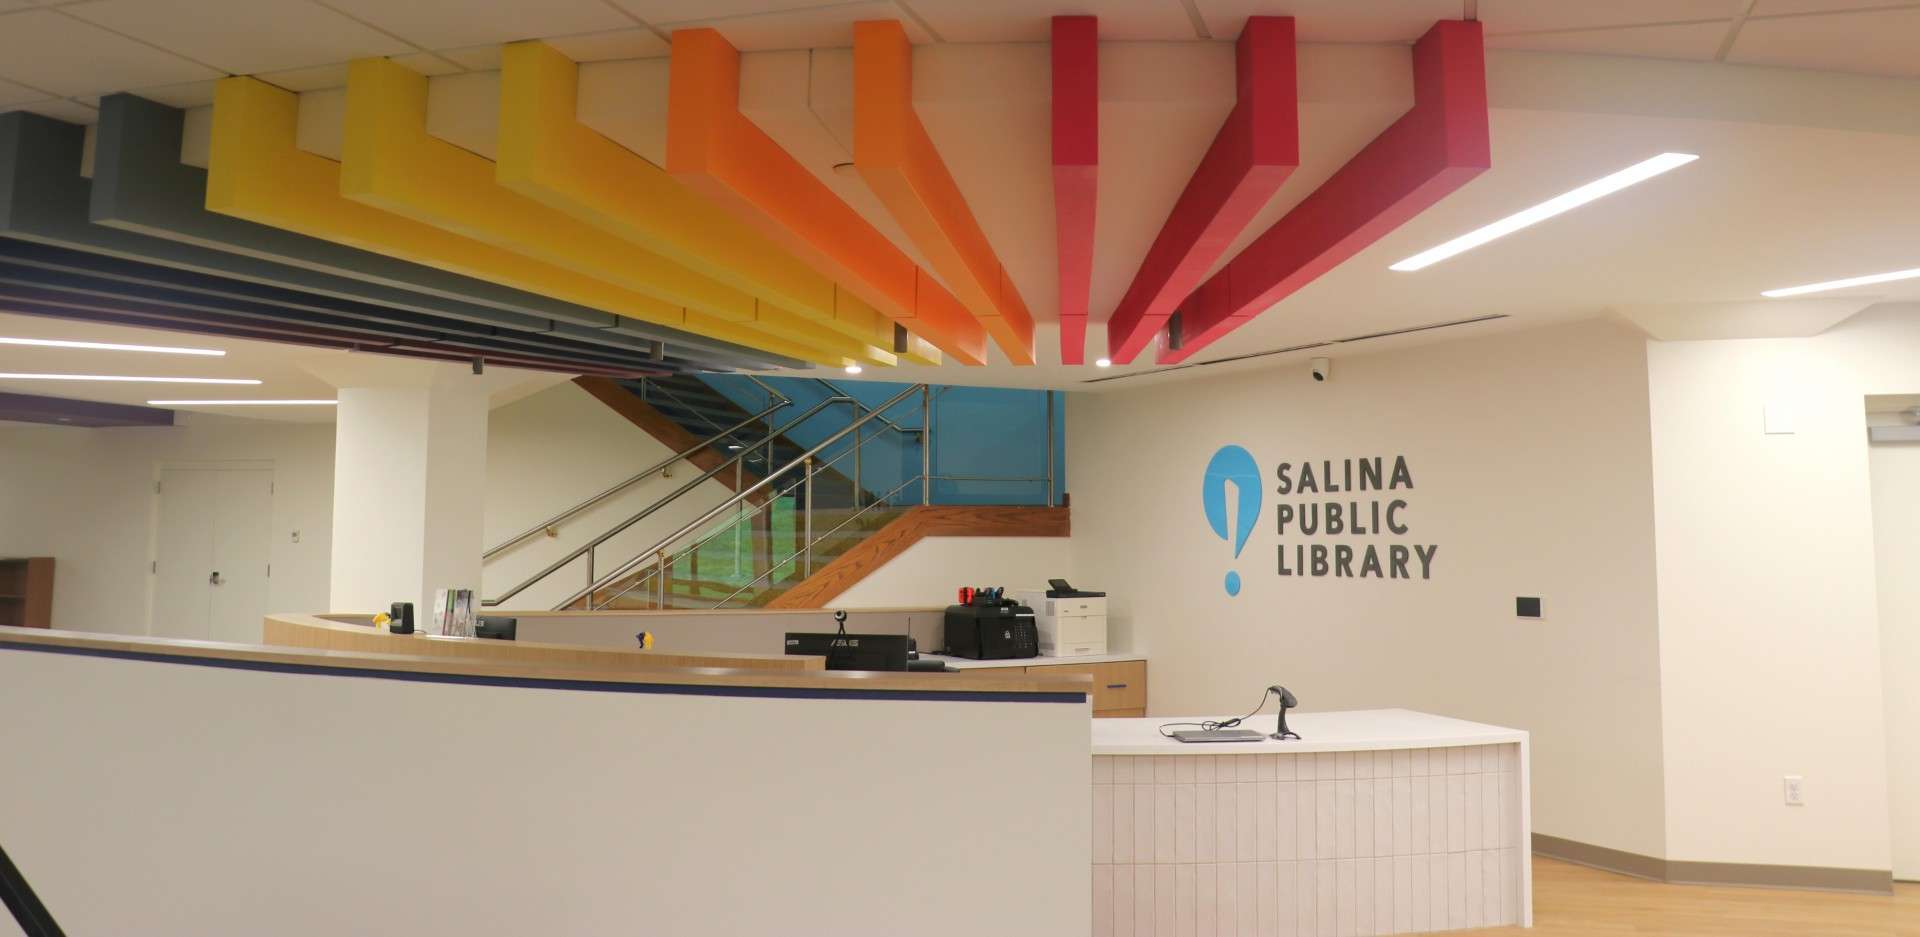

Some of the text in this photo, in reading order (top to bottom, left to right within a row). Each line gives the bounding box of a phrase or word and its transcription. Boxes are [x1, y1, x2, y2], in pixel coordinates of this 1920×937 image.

[1276, 455, 1414, 495] SALINA
[1277, 499, 1409, 536] PUBLIC
[1277, 544, 1438, 580] LIBRARY
